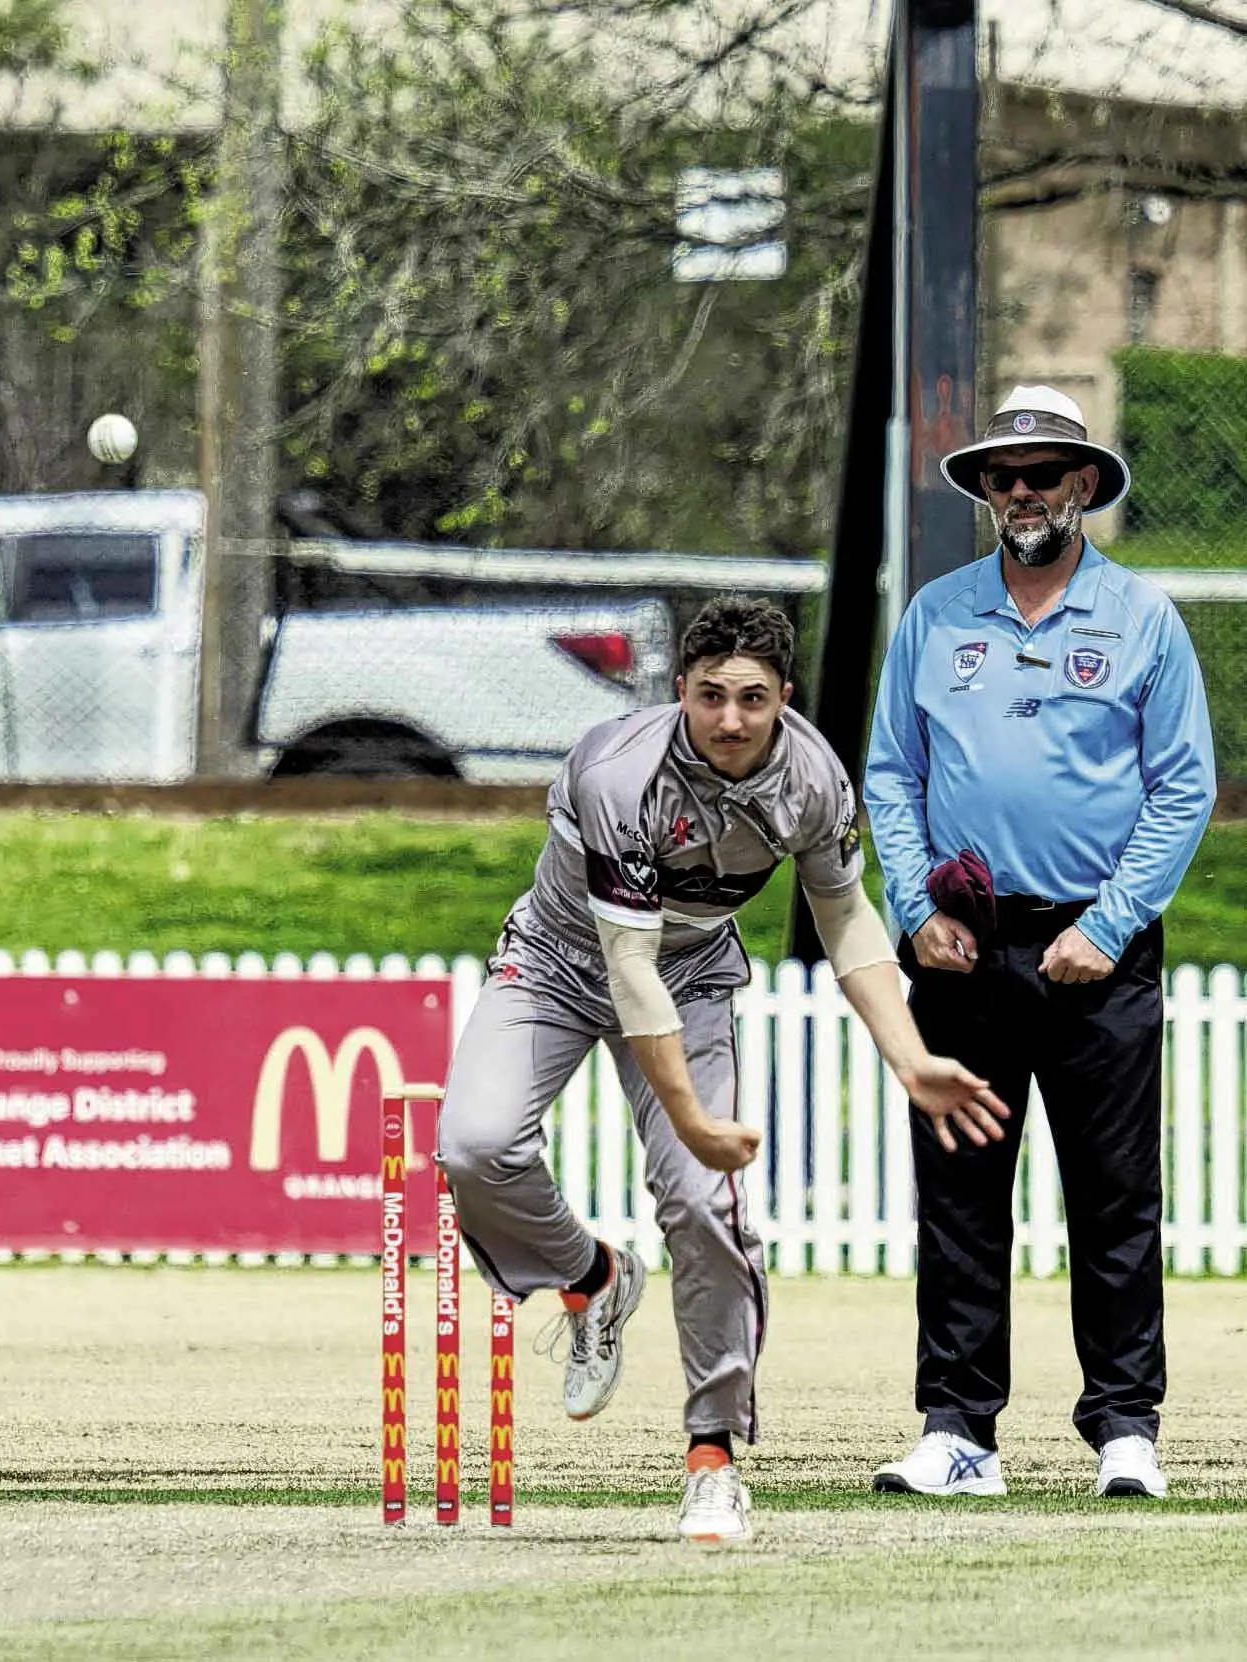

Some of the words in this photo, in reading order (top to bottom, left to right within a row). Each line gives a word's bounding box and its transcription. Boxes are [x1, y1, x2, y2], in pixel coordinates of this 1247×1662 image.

[72, 1086, 196, 1123] District
[41, 1133, 231, 1170] Association
[384, 1192, 403, 1336] McDonald's
[438, 1193, 459, 1336] McDonald's
